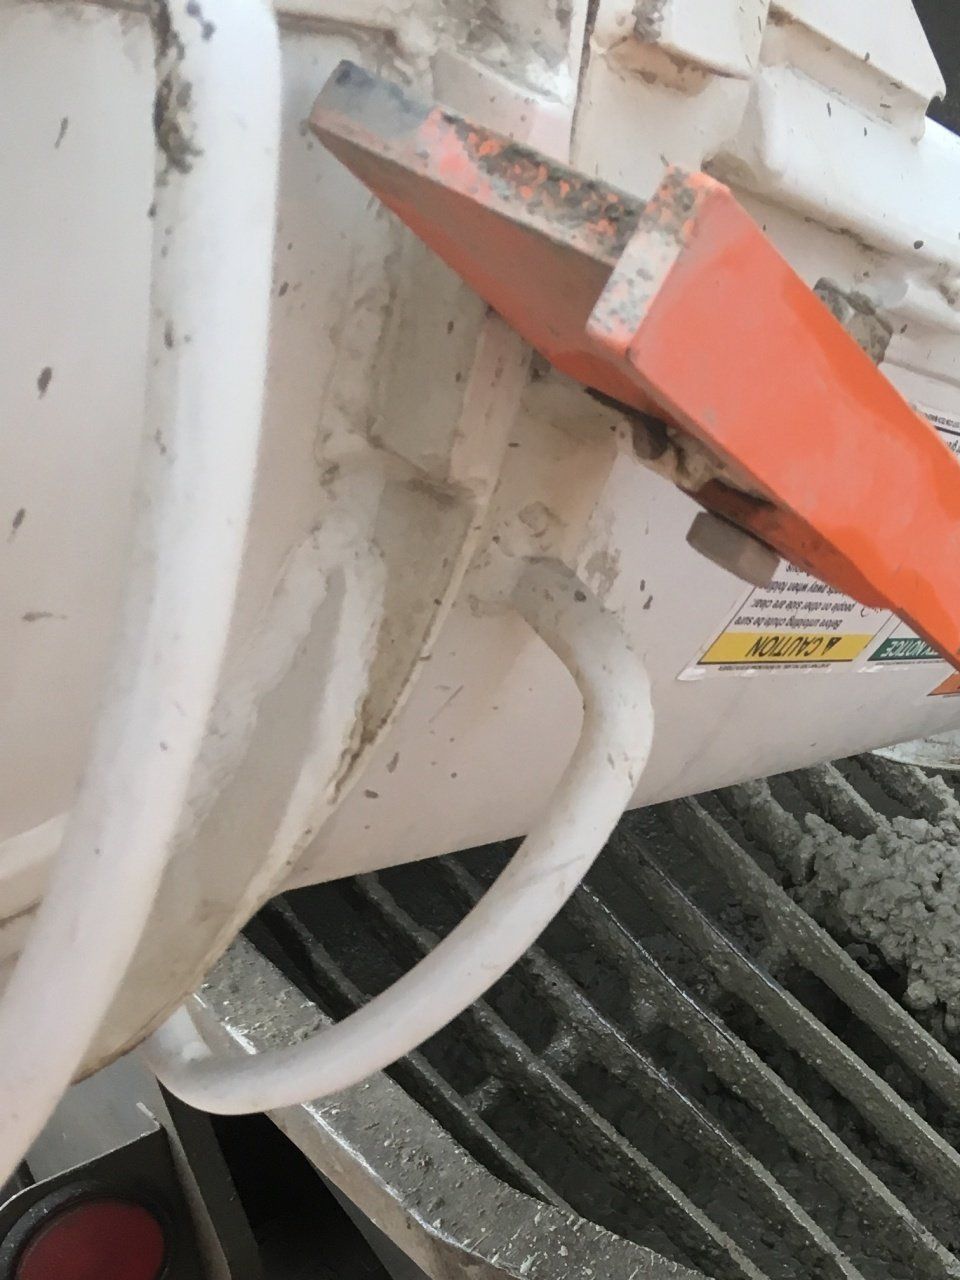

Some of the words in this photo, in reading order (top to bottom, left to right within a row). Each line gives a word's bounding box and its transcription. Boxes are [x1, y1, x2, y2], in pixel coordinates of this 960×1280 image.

[771, 599, 785, 609] are
[784, 600, 801, 611] side
[801, 601, 822, 612] other
[821, 602, 833, 611] on
[830, 601, 856, 613] people
[734, 615, 754, 625] sure
[752, 616, 766, 626] be
[764, 617, 787, 628] chute
[784, 615, 821, 630] unfolding
[819, 618, 843, 630] Before
[746, 636, 824, 657] CAUTION
[880, 639, 927, 657] NOTICE
